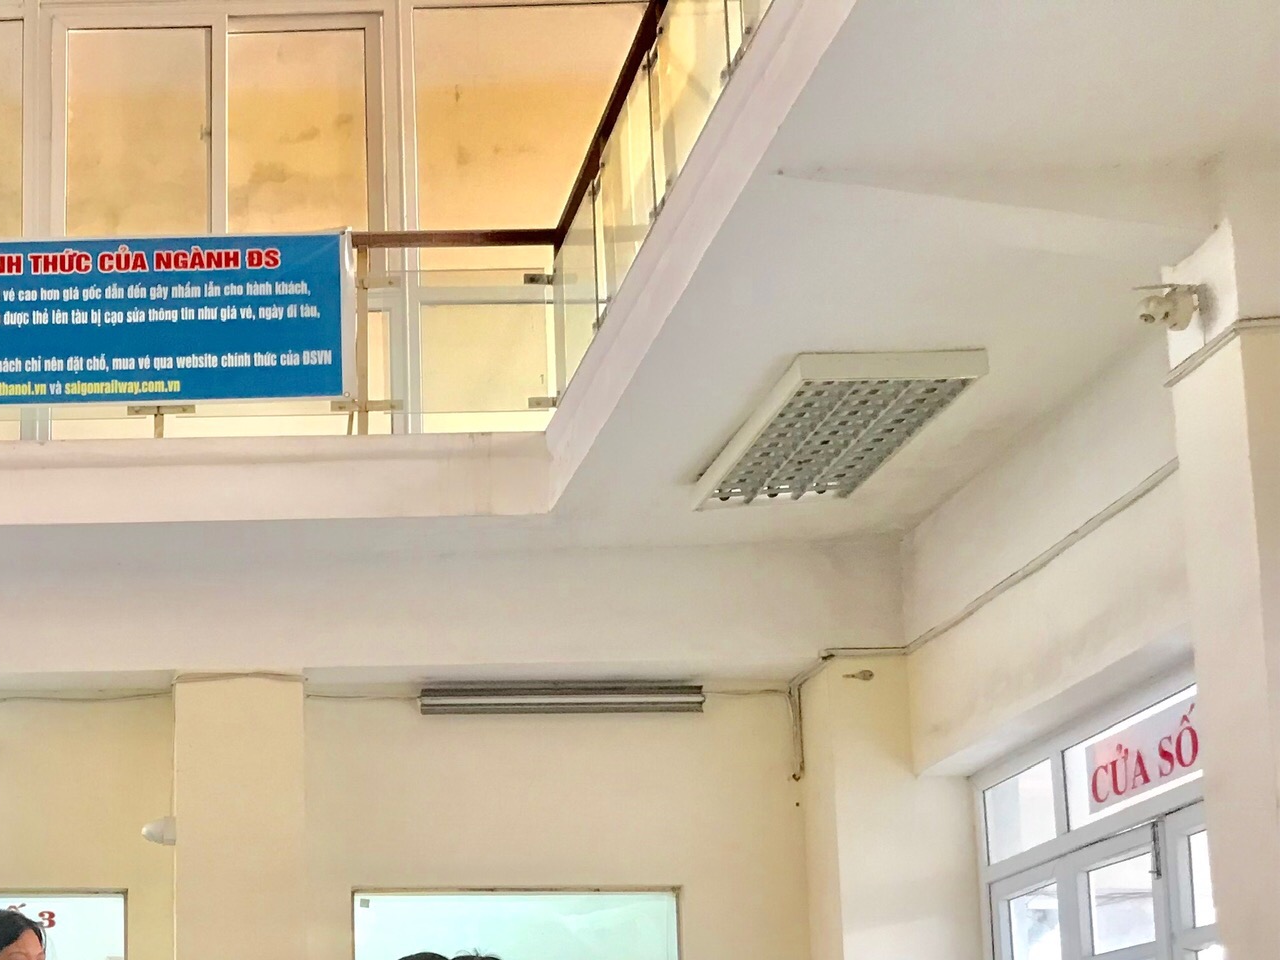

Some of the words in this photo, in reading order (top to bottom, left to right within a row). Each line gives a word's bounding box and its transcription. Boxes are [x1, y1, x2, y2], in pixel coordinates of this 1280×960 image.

[27, 248, 92, 275] THỨC
[97, 245, 149, 274] CỦA
[153, 245, 241, 272] NGÀNH
[245, 247, 281, 269] ĐS
[18, 290, 37, 301] cao
[40, 287, 59, 301] hơn
[82, 285, 101, 301] gốc
[105, 283, 124, 298] dẫn
[127, 283, 146, 298] đến
[171, 282, 200, 298] nhầm
[223, 283, 243, 295] cho
[246, 282, 272, 295] hành
[275, 281, 311, 295] khách,
[3, 311, 29, 327] được
[104, 311, 123, 325] cạo
[148, 308, 178, 323] thông
[197, 307, 217, 320] như
[258, 304, 283, 320] ngày
[300, 304, 319, 317] tàu,
[44, 357, 63, 371] nên
[86, 354, 108, 372] chỗ,
[112, 358, 135, 369] mua
[153, 357, 173, 371] qua
[176, 354, 217, 368] website
[221, 353, 250, 367] chính
[253, 353, 276, 366] thức
[280, 350, 299, 365] của
[302, 351, 332, 365] ĐSVN
[64, 379, 180, 396] saigonrailway.com.vn
[1091, 743, 1151, 804] CỬA
[1158, 703, 1199, 778] SỐ
[38, 911, 56, 929] 3
